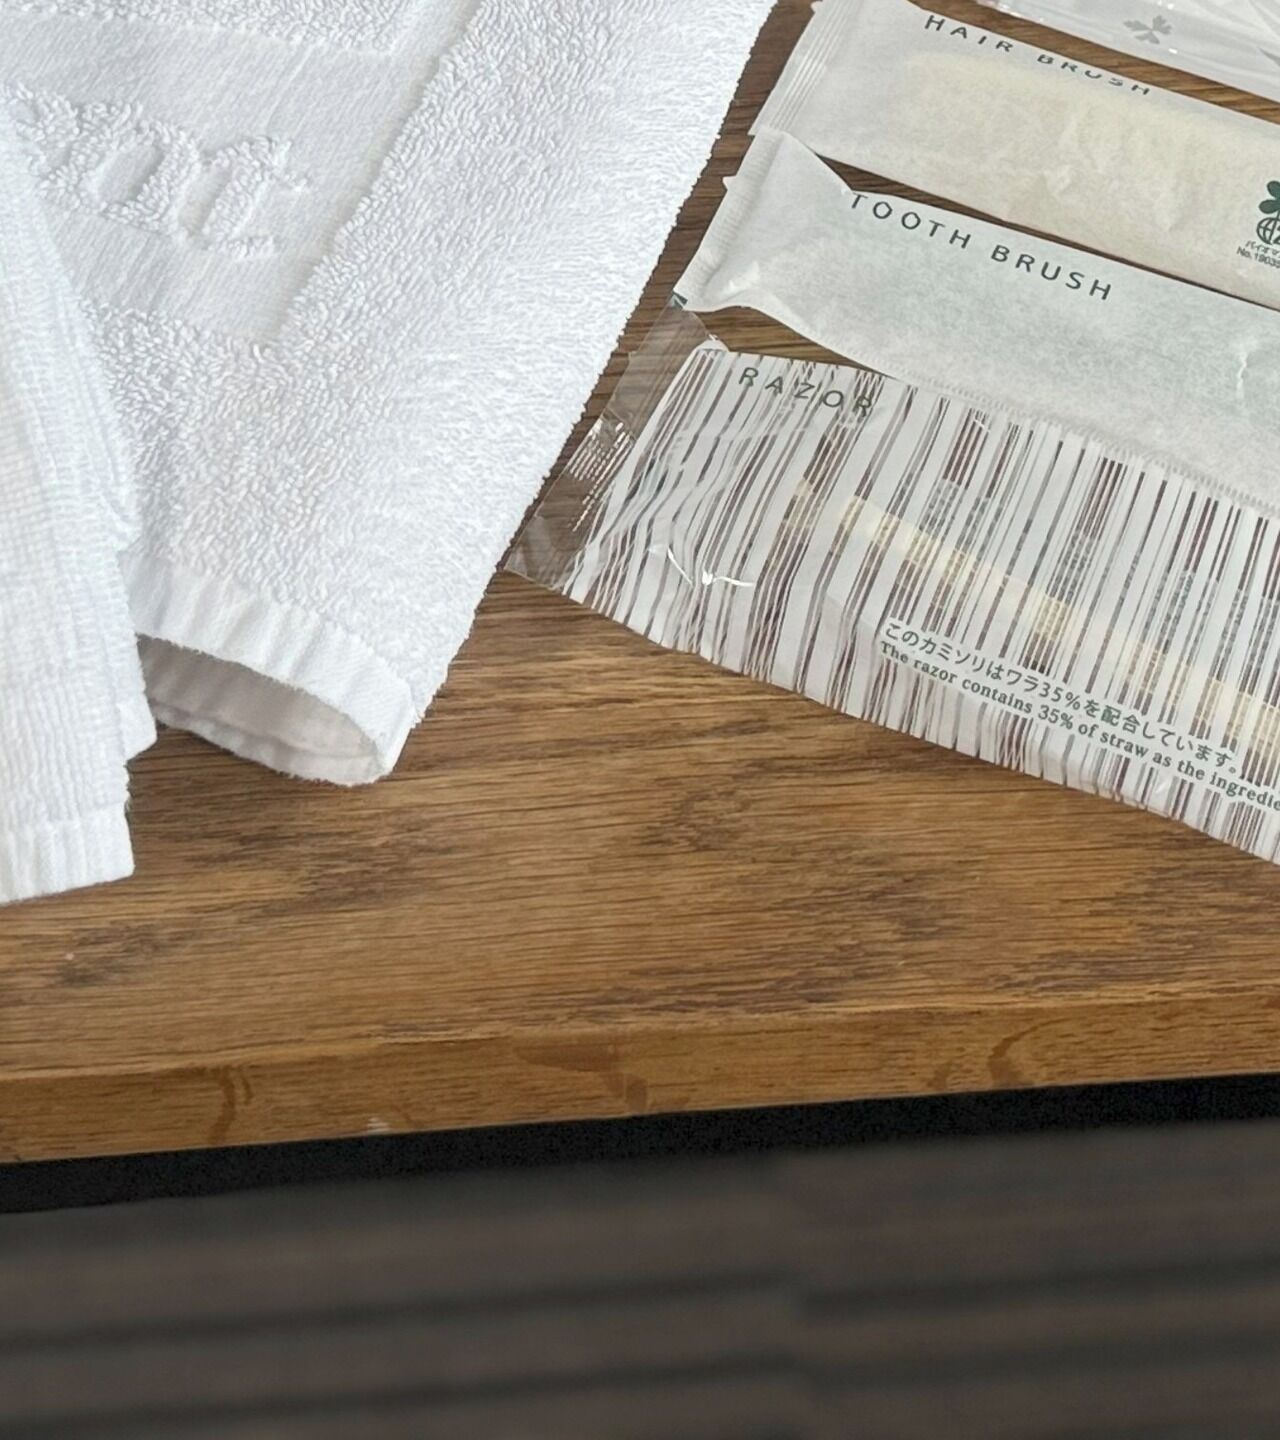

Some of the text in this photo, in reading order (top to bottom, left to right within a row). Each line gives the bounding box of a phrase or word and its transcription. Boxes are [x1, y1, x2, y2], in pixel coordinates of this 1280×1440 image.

[923, 14, 1151, 96] HAIR BRUSH
[850, 189, 1112, 302] TOOTH BRUSH
[737, 366, 874, 420] RAZOR
[879, 639, 910, 665] The
[912, 658, 958, 684] razor
[961, 678, 1034, 715] contains
[1036, 703, 1075, 731] 35%
[1077, 723, 1100, 739] of
[1099, 730, 1150, 759] straw
[1151, 751, 1173, 768] as
[1176, 759, 1206, 782] the
